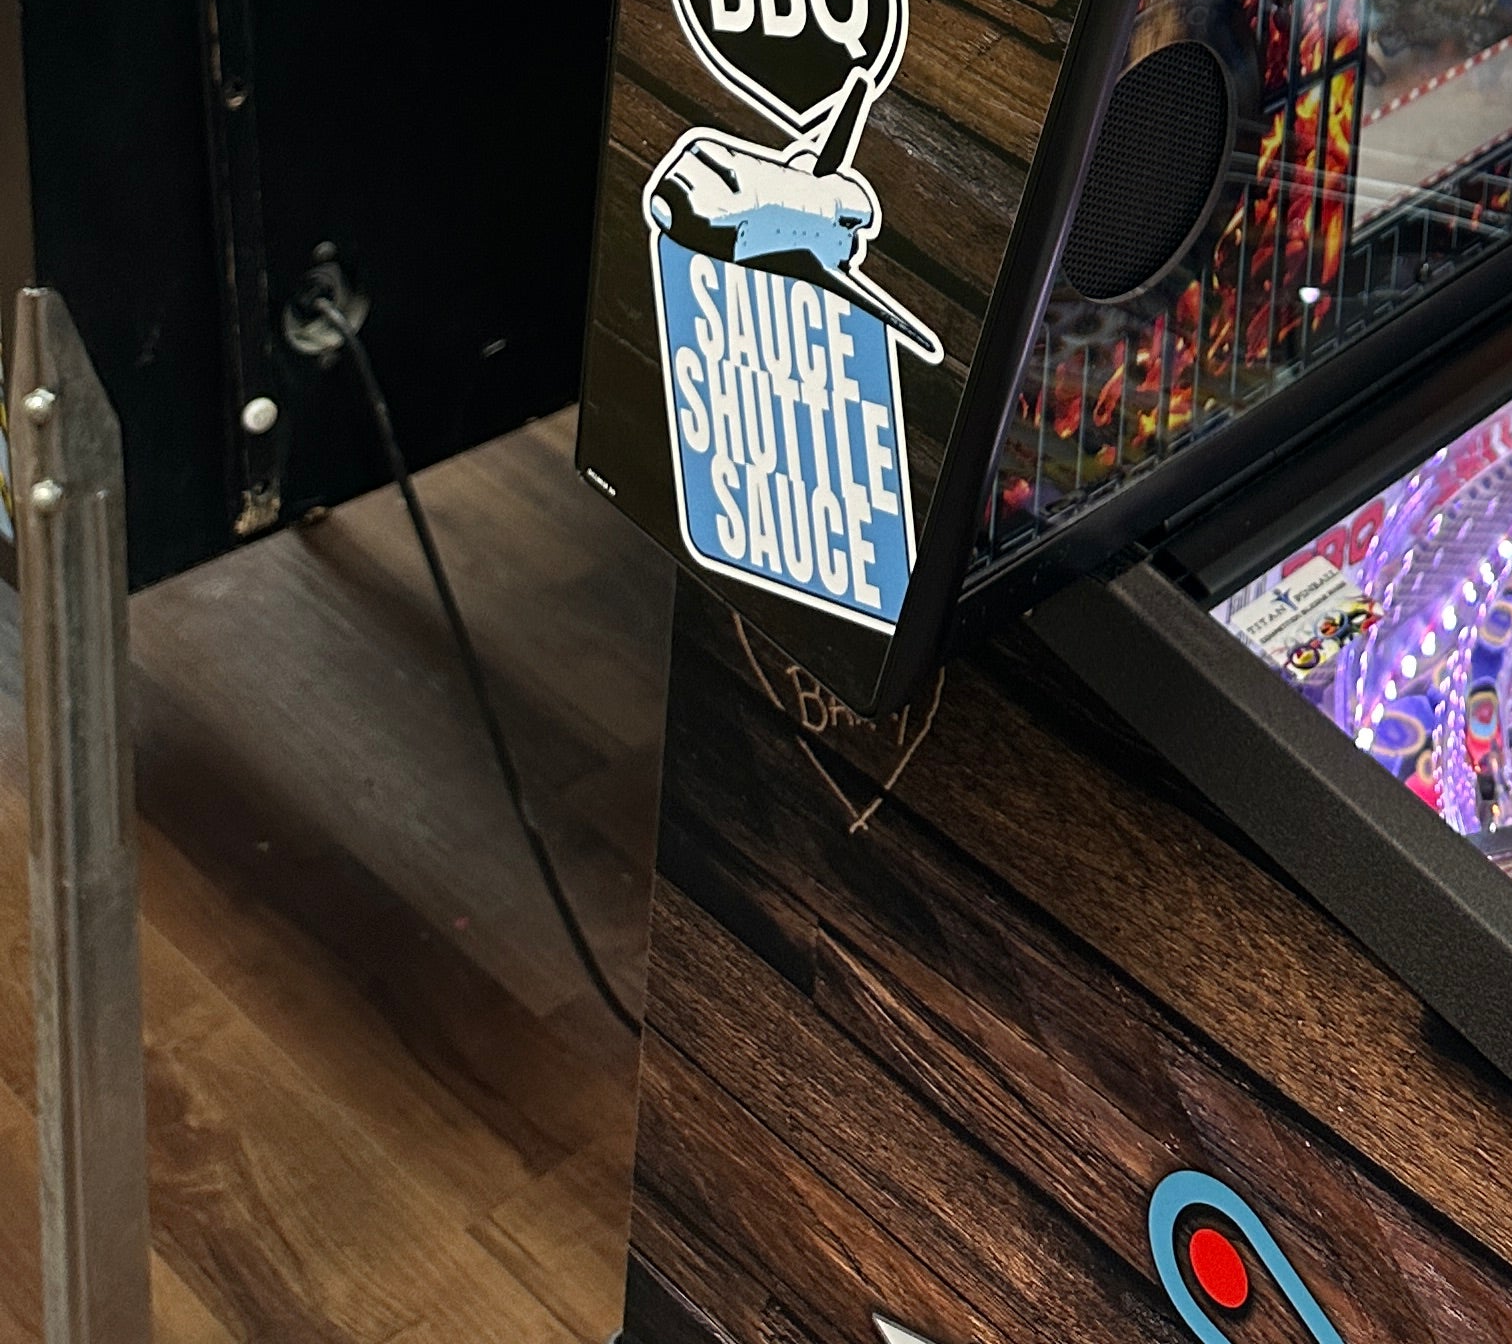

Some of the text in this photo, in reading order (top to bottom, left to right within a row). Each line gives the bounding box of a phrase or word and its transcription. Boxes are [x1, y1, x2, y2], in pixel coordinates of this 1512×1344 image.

[690, 253, 860, 404] SAUCE
[674, 346, 899, 516] SHUTTLE
[709, 458, 882, 610] SAUCE
[1247, 569, 1340, 635] TITAN PINBALL
